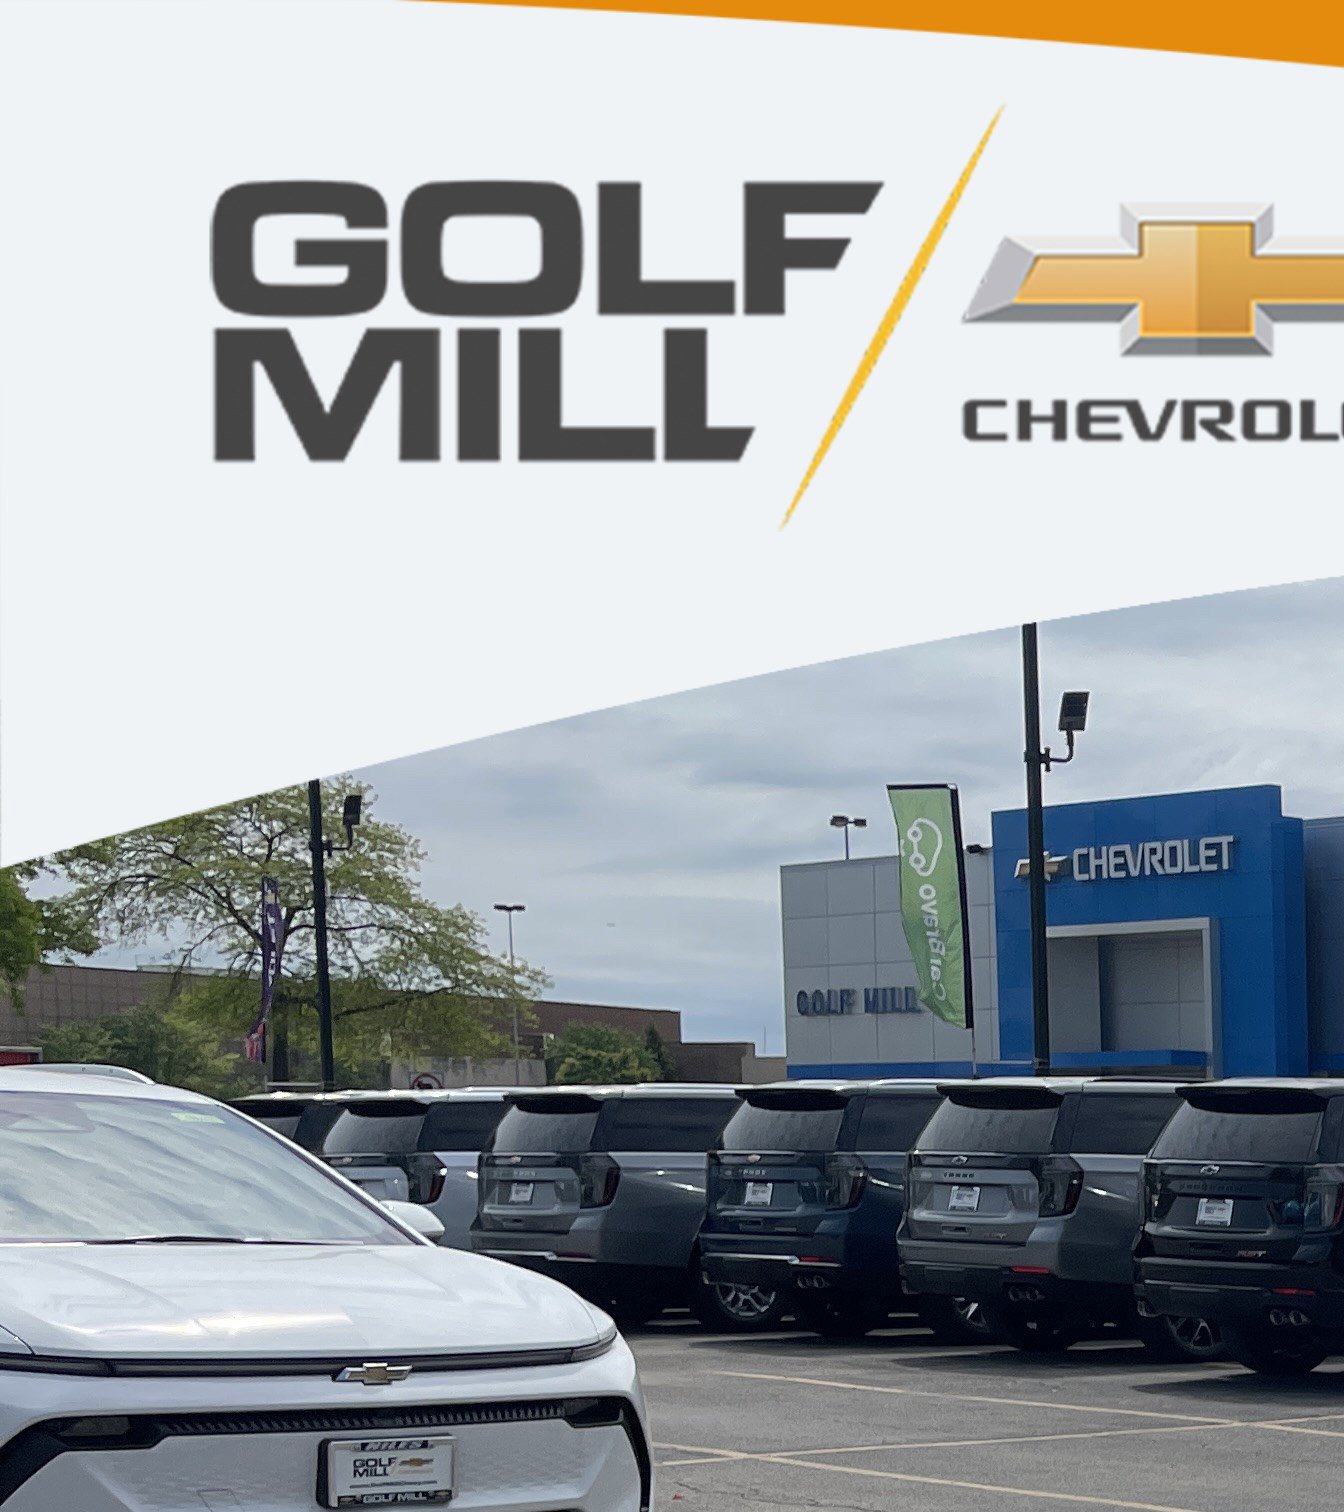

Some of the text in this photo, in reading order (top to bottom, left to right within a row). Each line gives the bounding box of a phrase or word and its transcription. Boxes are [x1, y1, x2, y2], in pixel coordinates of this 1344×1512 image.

[1072, 834, 1234, 881] CHEVROLET
[796, 989, 857, 1016] GOLF
[353, 1457, 397, 1469] GOLF
[353, 1467, 389, 1478] MILL
[362, 1490, 427, 1504] GOLF MILL
